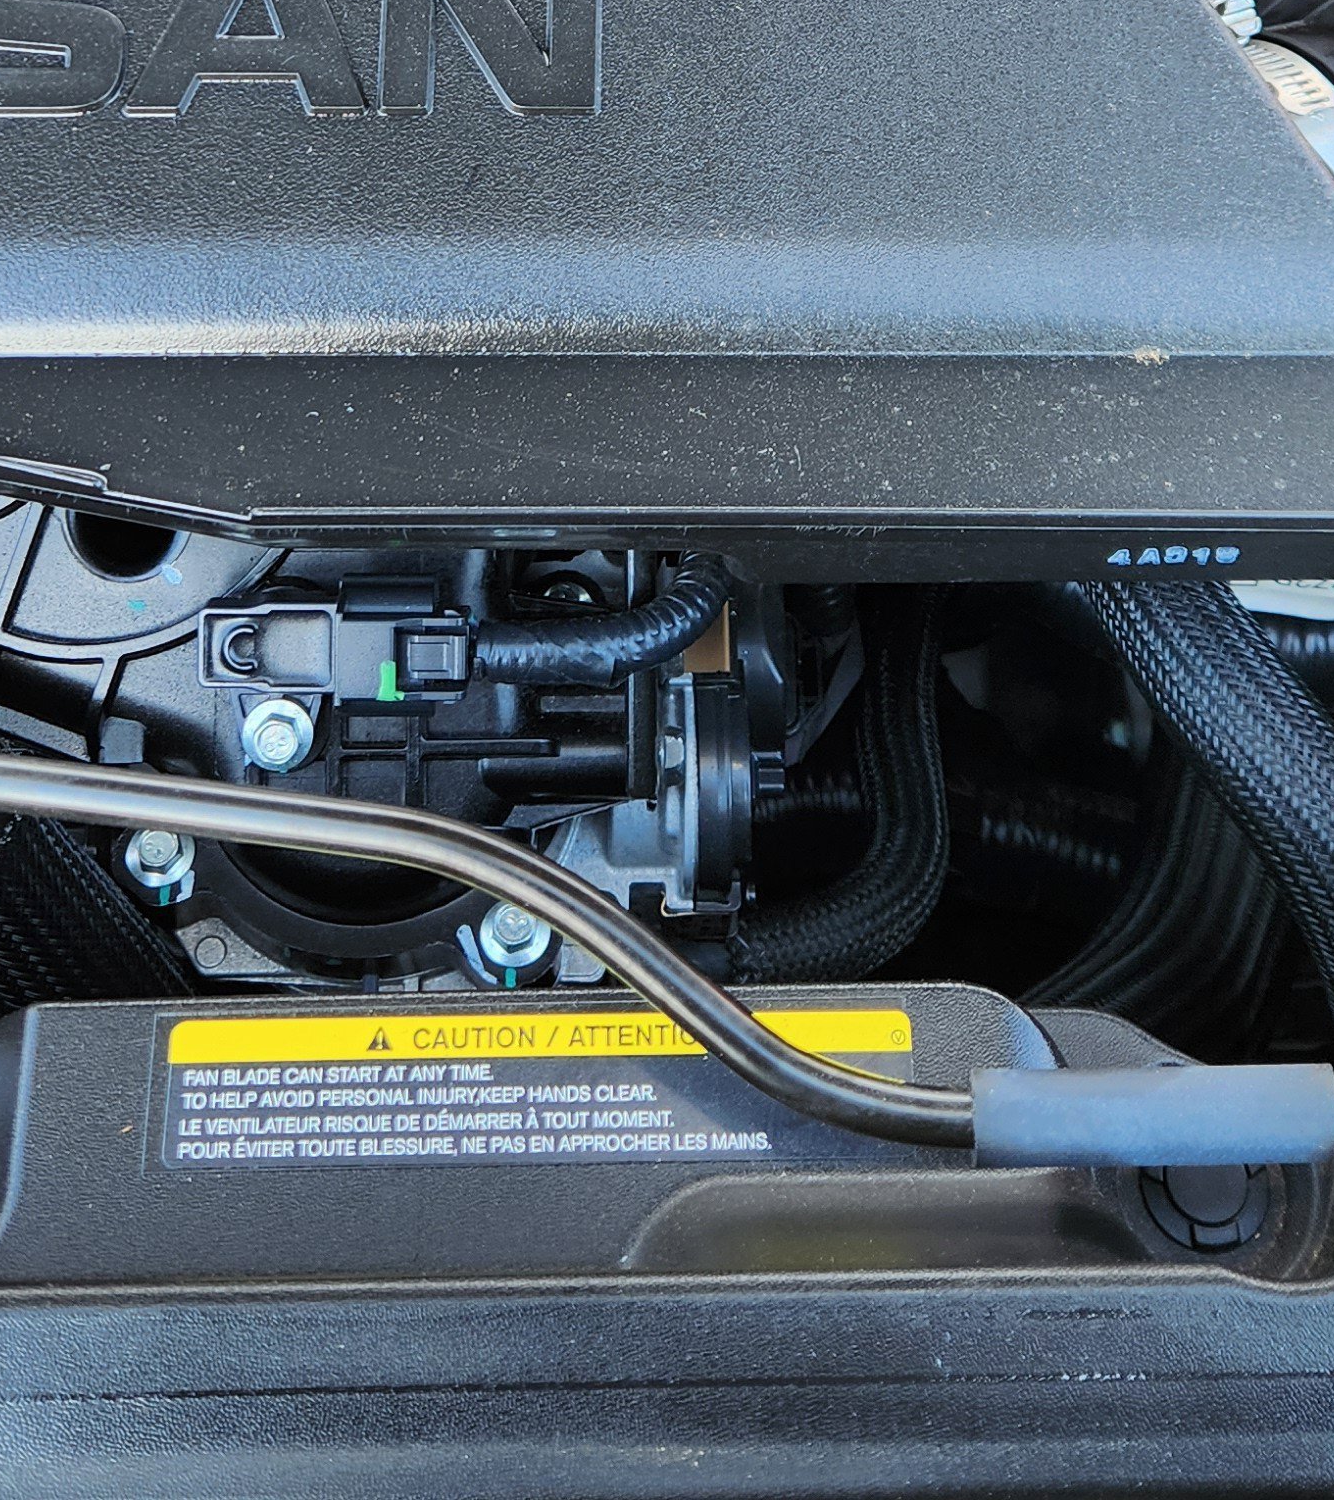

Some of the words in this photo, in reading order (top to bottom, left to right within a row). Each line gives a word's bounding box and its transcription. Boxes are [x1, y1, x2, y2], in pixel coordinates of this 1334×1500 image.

[413, 1026, 535, 1049] CAUTION
[547, 1025, 558, 1048] /
[183, 1069, 218, 1086] FAN
[222, 1068, 280, 1085] BLADE
[282, 1067, 322, 1084] CAN
[325, 1066, 381, 1083] START
[384, 1066, 406, 1083] AT
[408, 1065, 446, 1082] ANY
[448, 1064, 494, 1081] TIME.
[181, 1092, 207, 1109] TO
[210, 1092, 257, 1109] HELP
[258, 1090, 315, 1108] AVOID
[319, 1088, 413, 1106] PERSONAL
[528, 1085, 591, 1102] HANDS
[595, 1084, 657, 1101] CLEAR.
[179, 1118, 202, 1136] LE
[205, 1116, 320, 1134] VENTILATEUR
[324, 1114, 391, 1133] RISQUE
[394, 1113, 421, 1132] DE
[423, 1108, 523, 1131] DÉMARRER
[542, 1111, 590, 1129] TOUT
[594, 1110, 675, 1128] MOMENT.
[177, 1142, 231, 1159] POUR
[233, 1136, 295, 1158] ÉVITER
[297, 1139, 356, 1157] TOUTE
[359, 1137, 458, 1156] BLESSURE,
[462, 1136, 487, 1153] NE
[491, 1135, 525, 1153] PAS
[529, 1135, 555, 1152] EN
[557, 1134, 670, 1152] APPROCHER
[673, 1133, 707, 1150] LES
[710, 1132, 773, 1150] MAINS.
